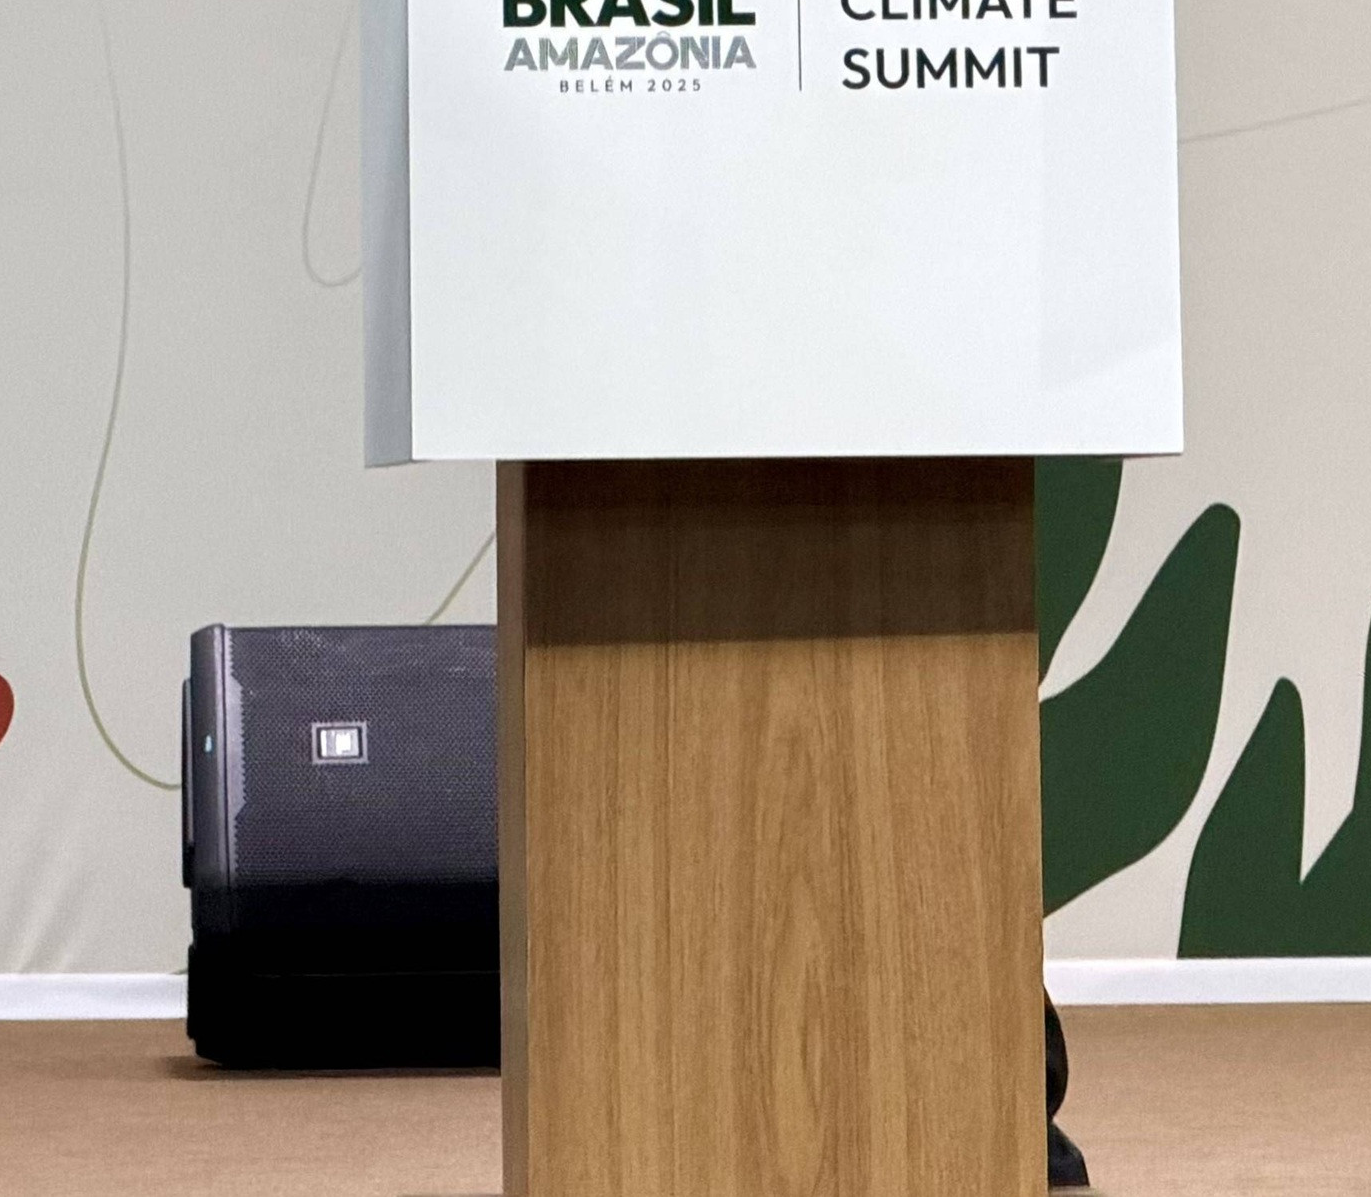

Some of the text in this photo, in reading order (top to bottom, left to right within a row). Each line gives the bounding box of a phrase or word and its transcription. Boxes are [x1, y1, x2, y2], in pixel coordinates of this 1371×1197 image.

[504, 31, 757, 72] AMAZÔNIA
[843, 46, 1059, 89] SUMMIT
[560, 76, 701, 93] BELÉM 2025
